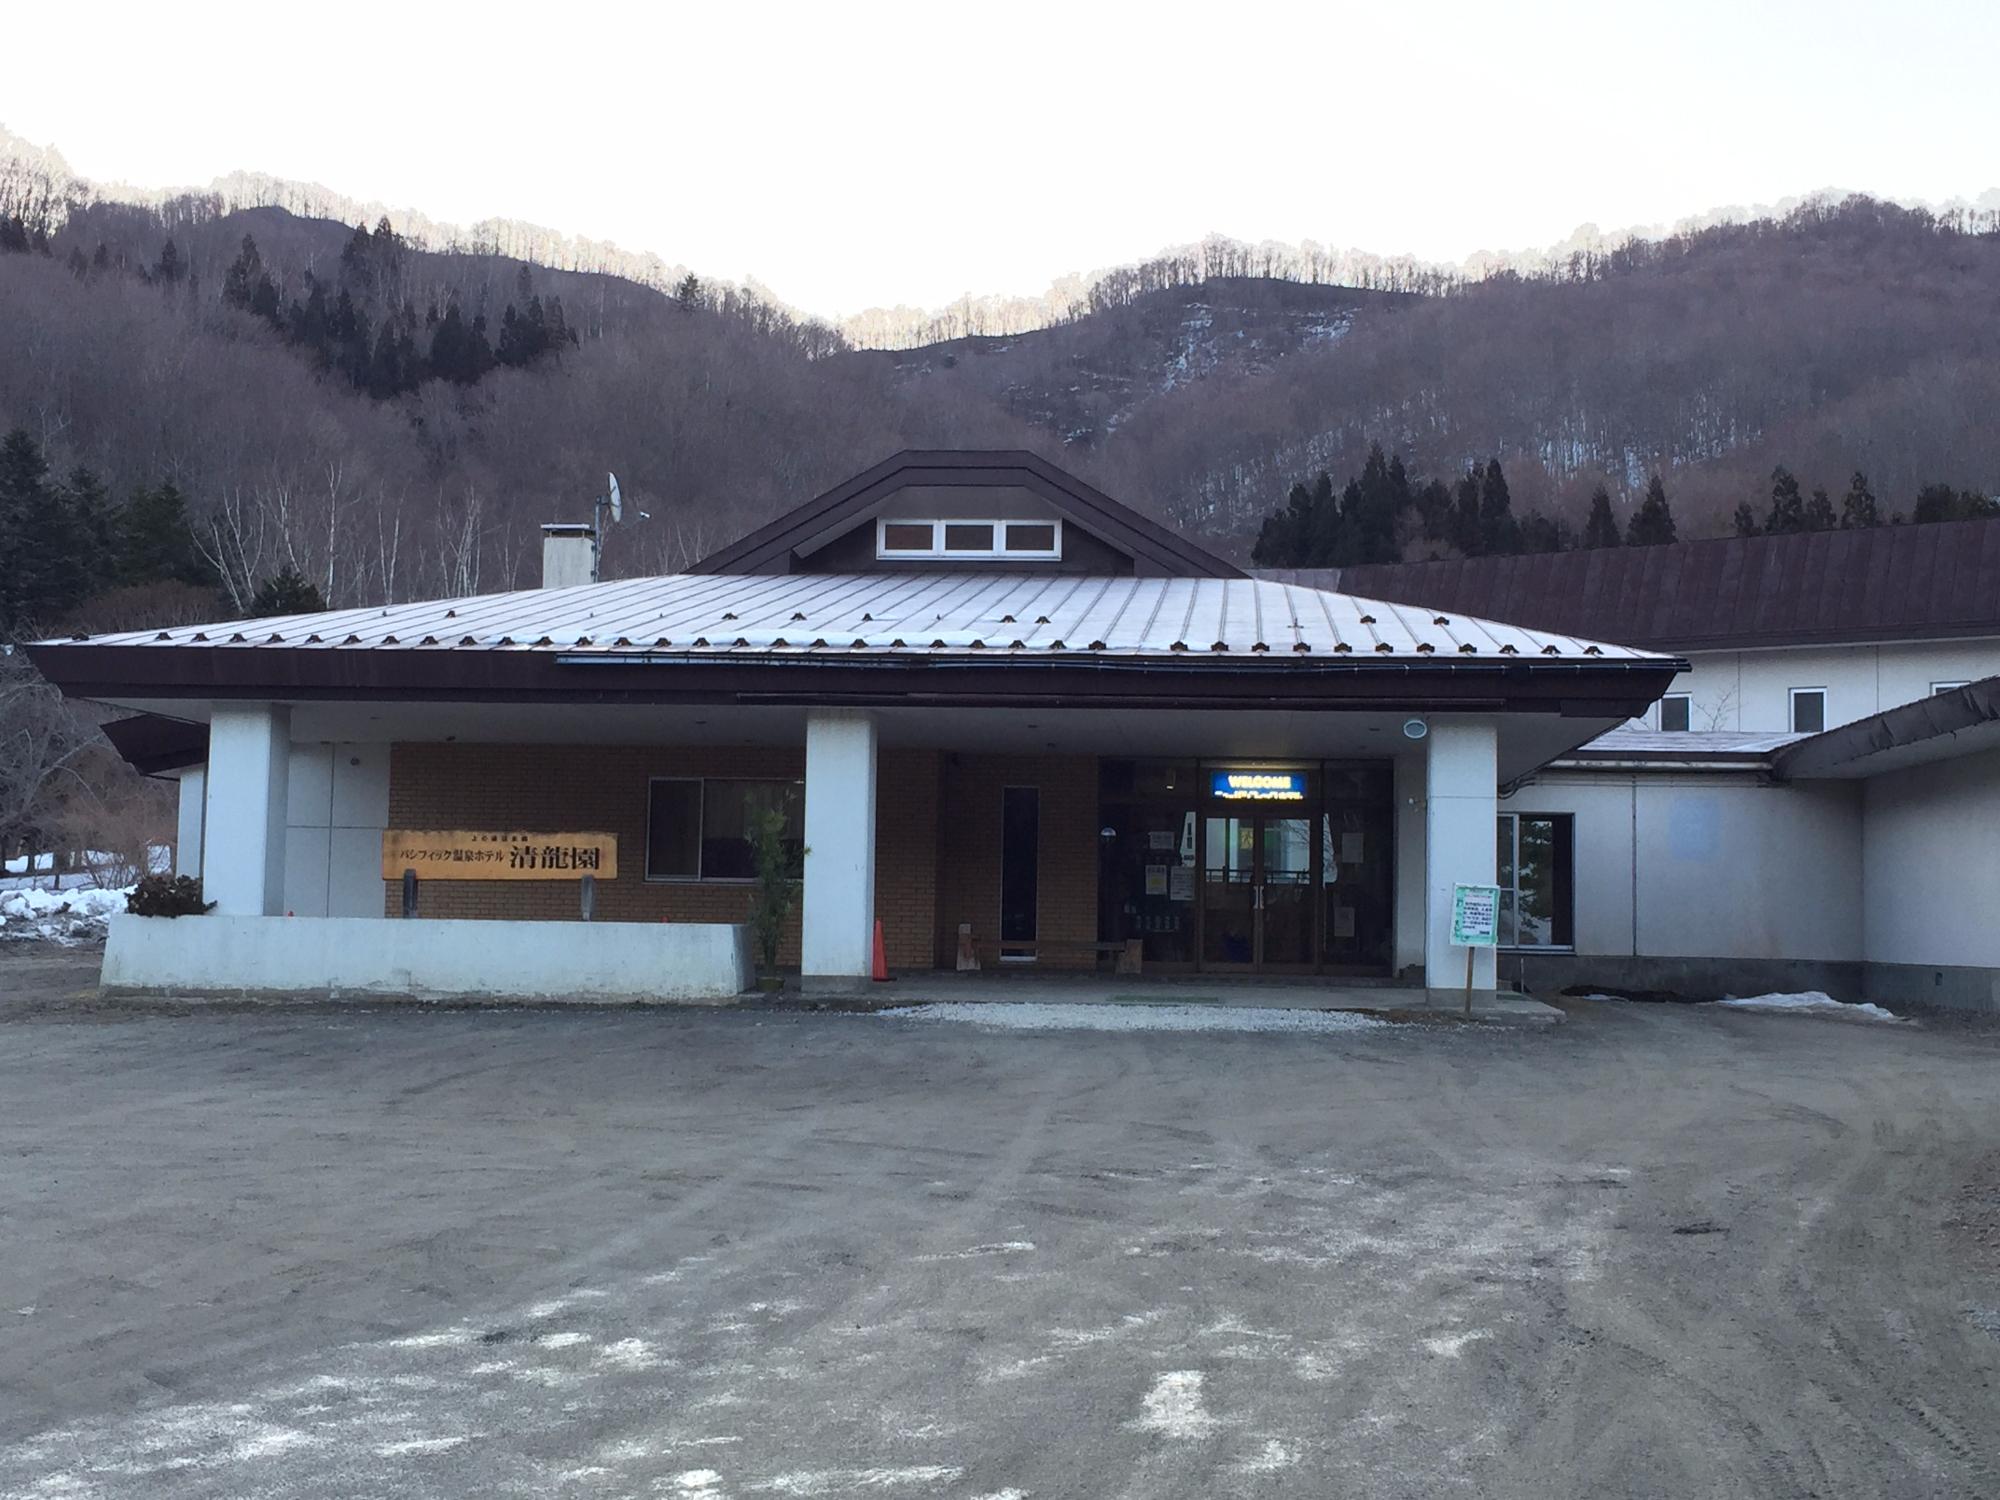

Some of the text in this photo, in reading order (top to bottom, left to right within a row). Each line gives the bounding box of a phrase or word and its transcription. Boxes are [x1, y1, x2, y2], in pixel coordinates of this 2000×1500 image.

[1228, 775, 1291, 789] WELCOME
[400, 845, 600, 870] パシフィック温泉ホテル 清龍園
